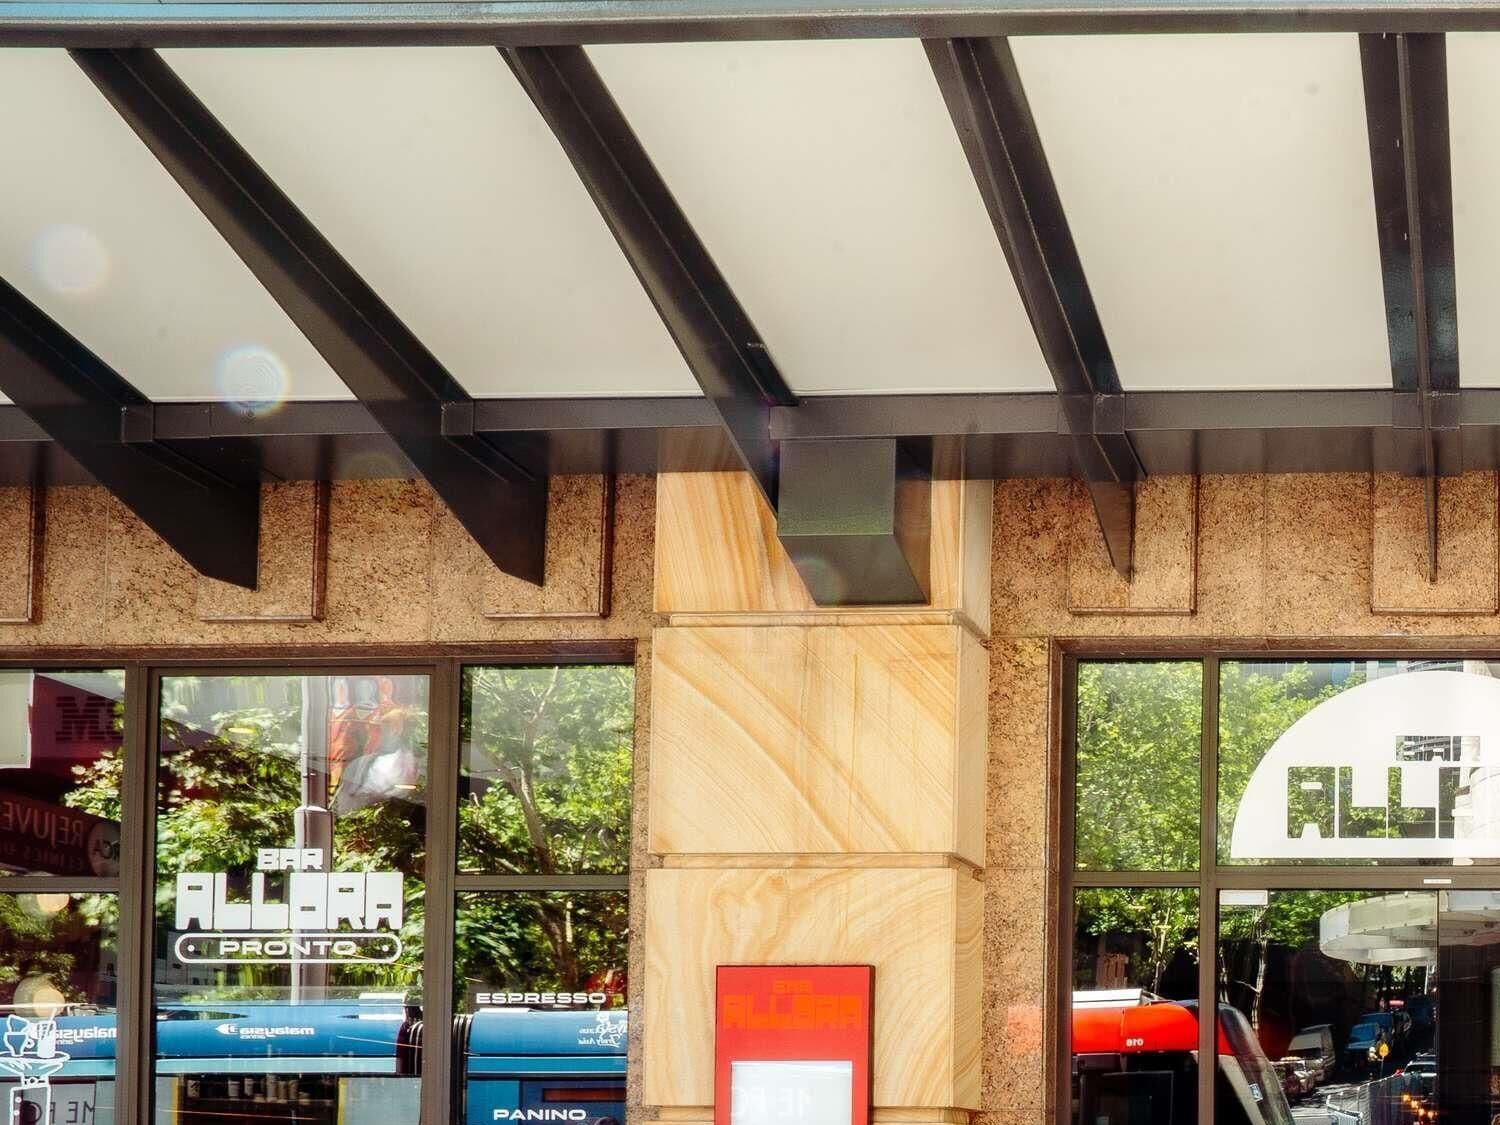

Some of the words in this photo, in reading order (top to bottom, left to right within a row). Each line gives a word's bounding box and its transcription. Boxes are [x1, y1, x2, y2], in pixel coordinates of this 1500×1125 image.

[1396, 735, 1481, 762] BAR
[258, 848, 324, 870] BAR
[175, 871, 404, 930] ALLORA
[220, 940, 357, 956] PRONTO
[773, 980, 813, 994] BAR
[476, 992, 607, 1005] ESPRESSO
[723, 994, 862, 1030] ALLORA
[493, 1108, 587, 1121] PANINO
